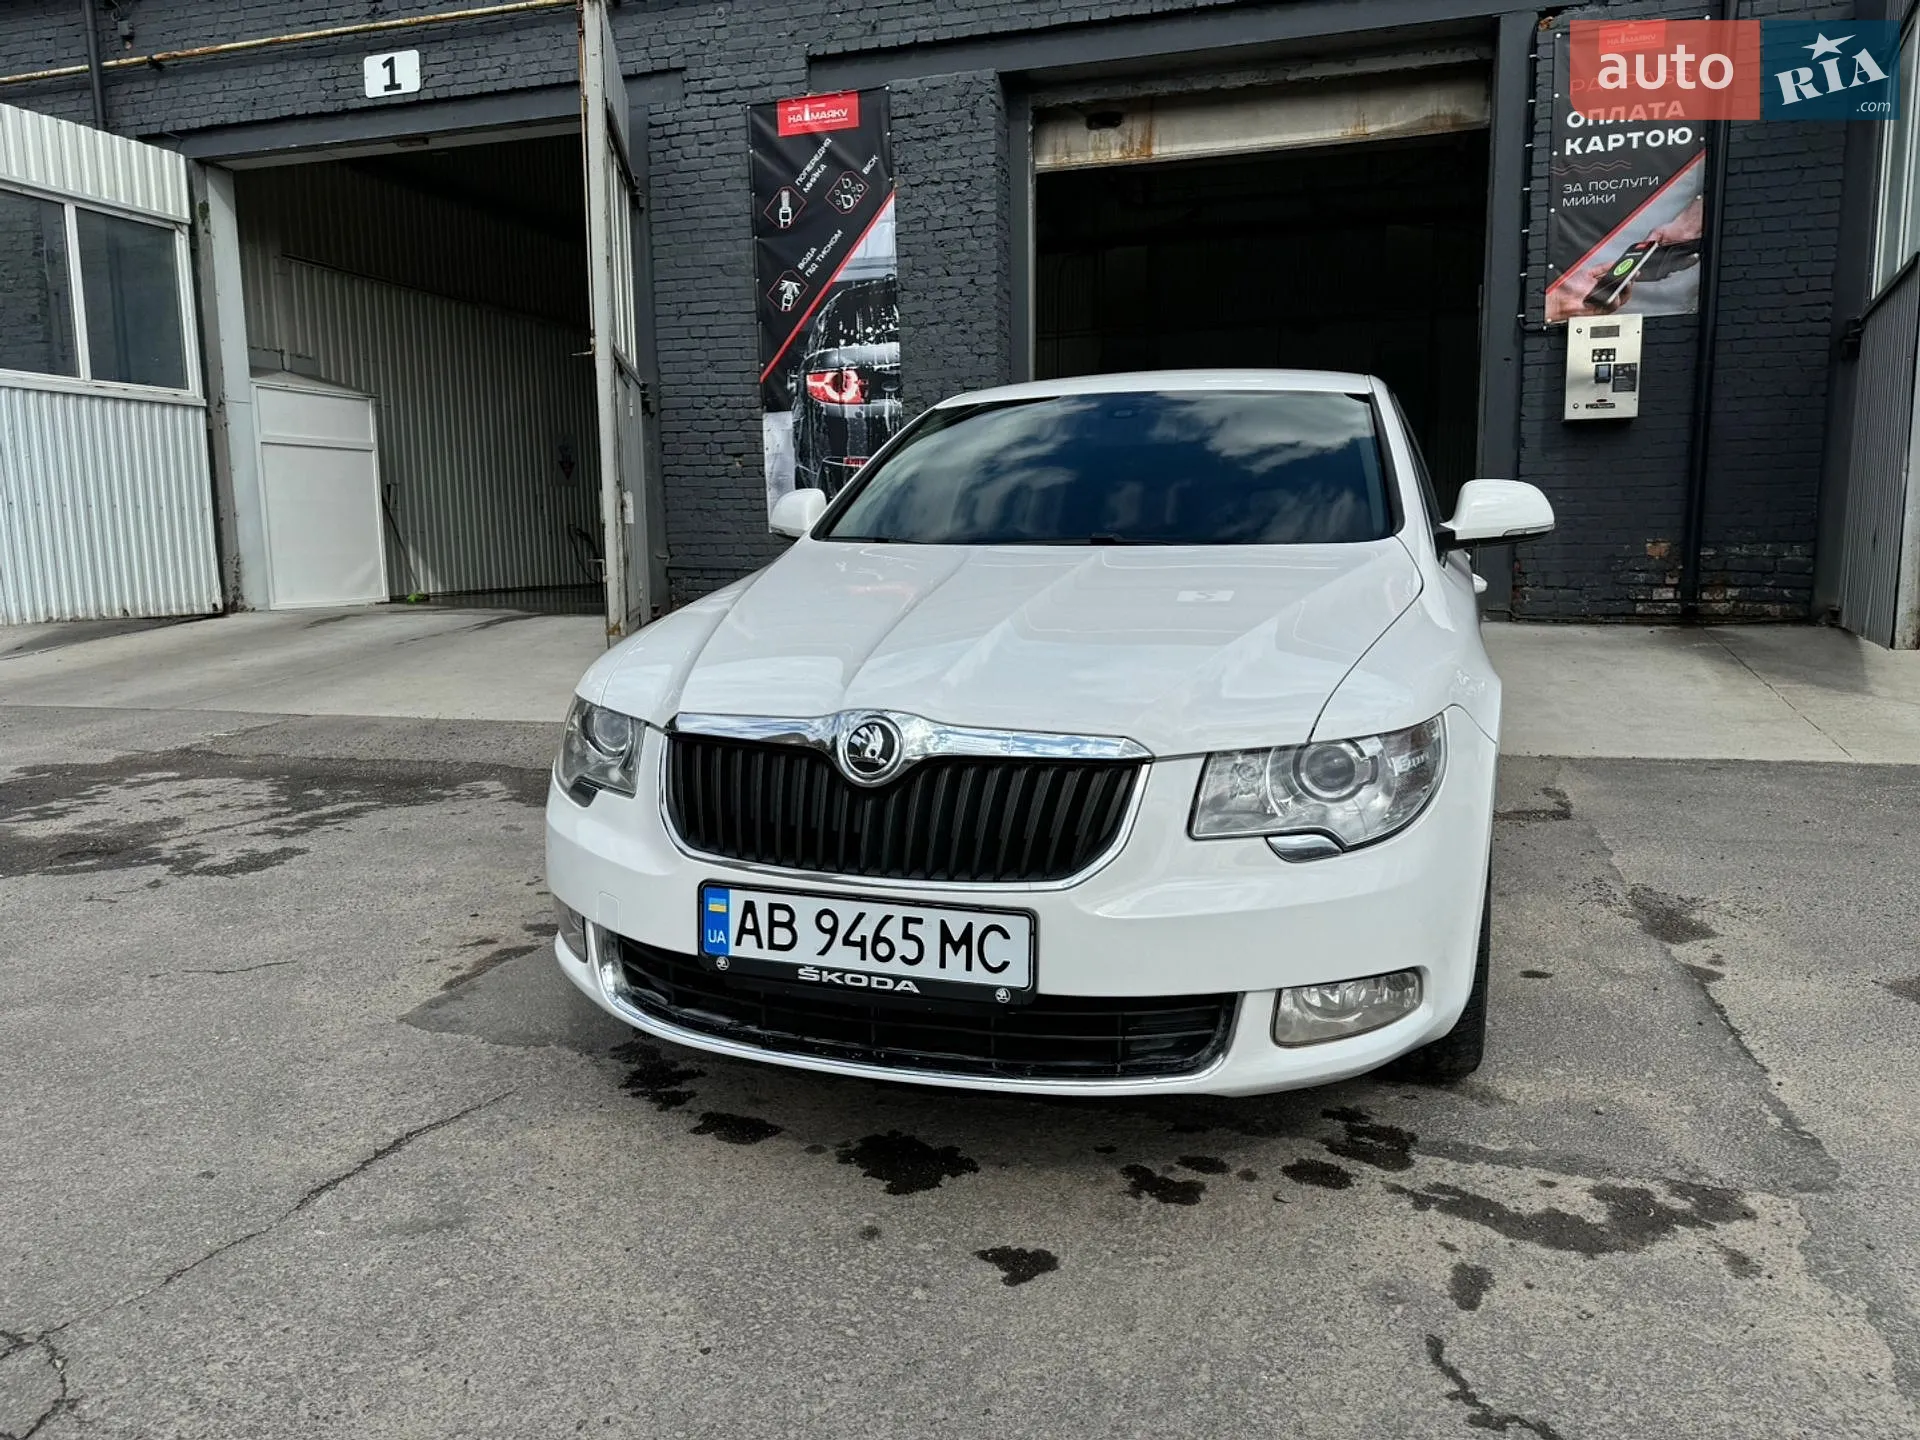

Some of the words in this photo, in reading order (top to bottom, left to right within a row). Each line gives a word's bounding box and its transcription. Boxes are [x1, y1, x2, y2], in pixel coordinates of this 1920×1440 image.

[381, 56, 402, 92] 1
[1566, 100, 1686, 128] ОПЛАТА
[1564, 126, 1694, 156] КАРТОЮ
[795, 137, 833, 186] ПОПЕРЕДНЯ
[1562, 183, 1584, 194] ЗА
[1588, 175, 1660, 192] ПОСЛУГИ
[1562, 193, 1617, 207] МИЙКИ
[797, 246, 818, 271] ВОДА
[708, 930, 727, 944] UA
[735, 900, 799, 952] AB
[814, 907, 926, 967] 9465
[938, 918, 1012, 975] MC
[797, 965, 921, 994] ŠKODA
